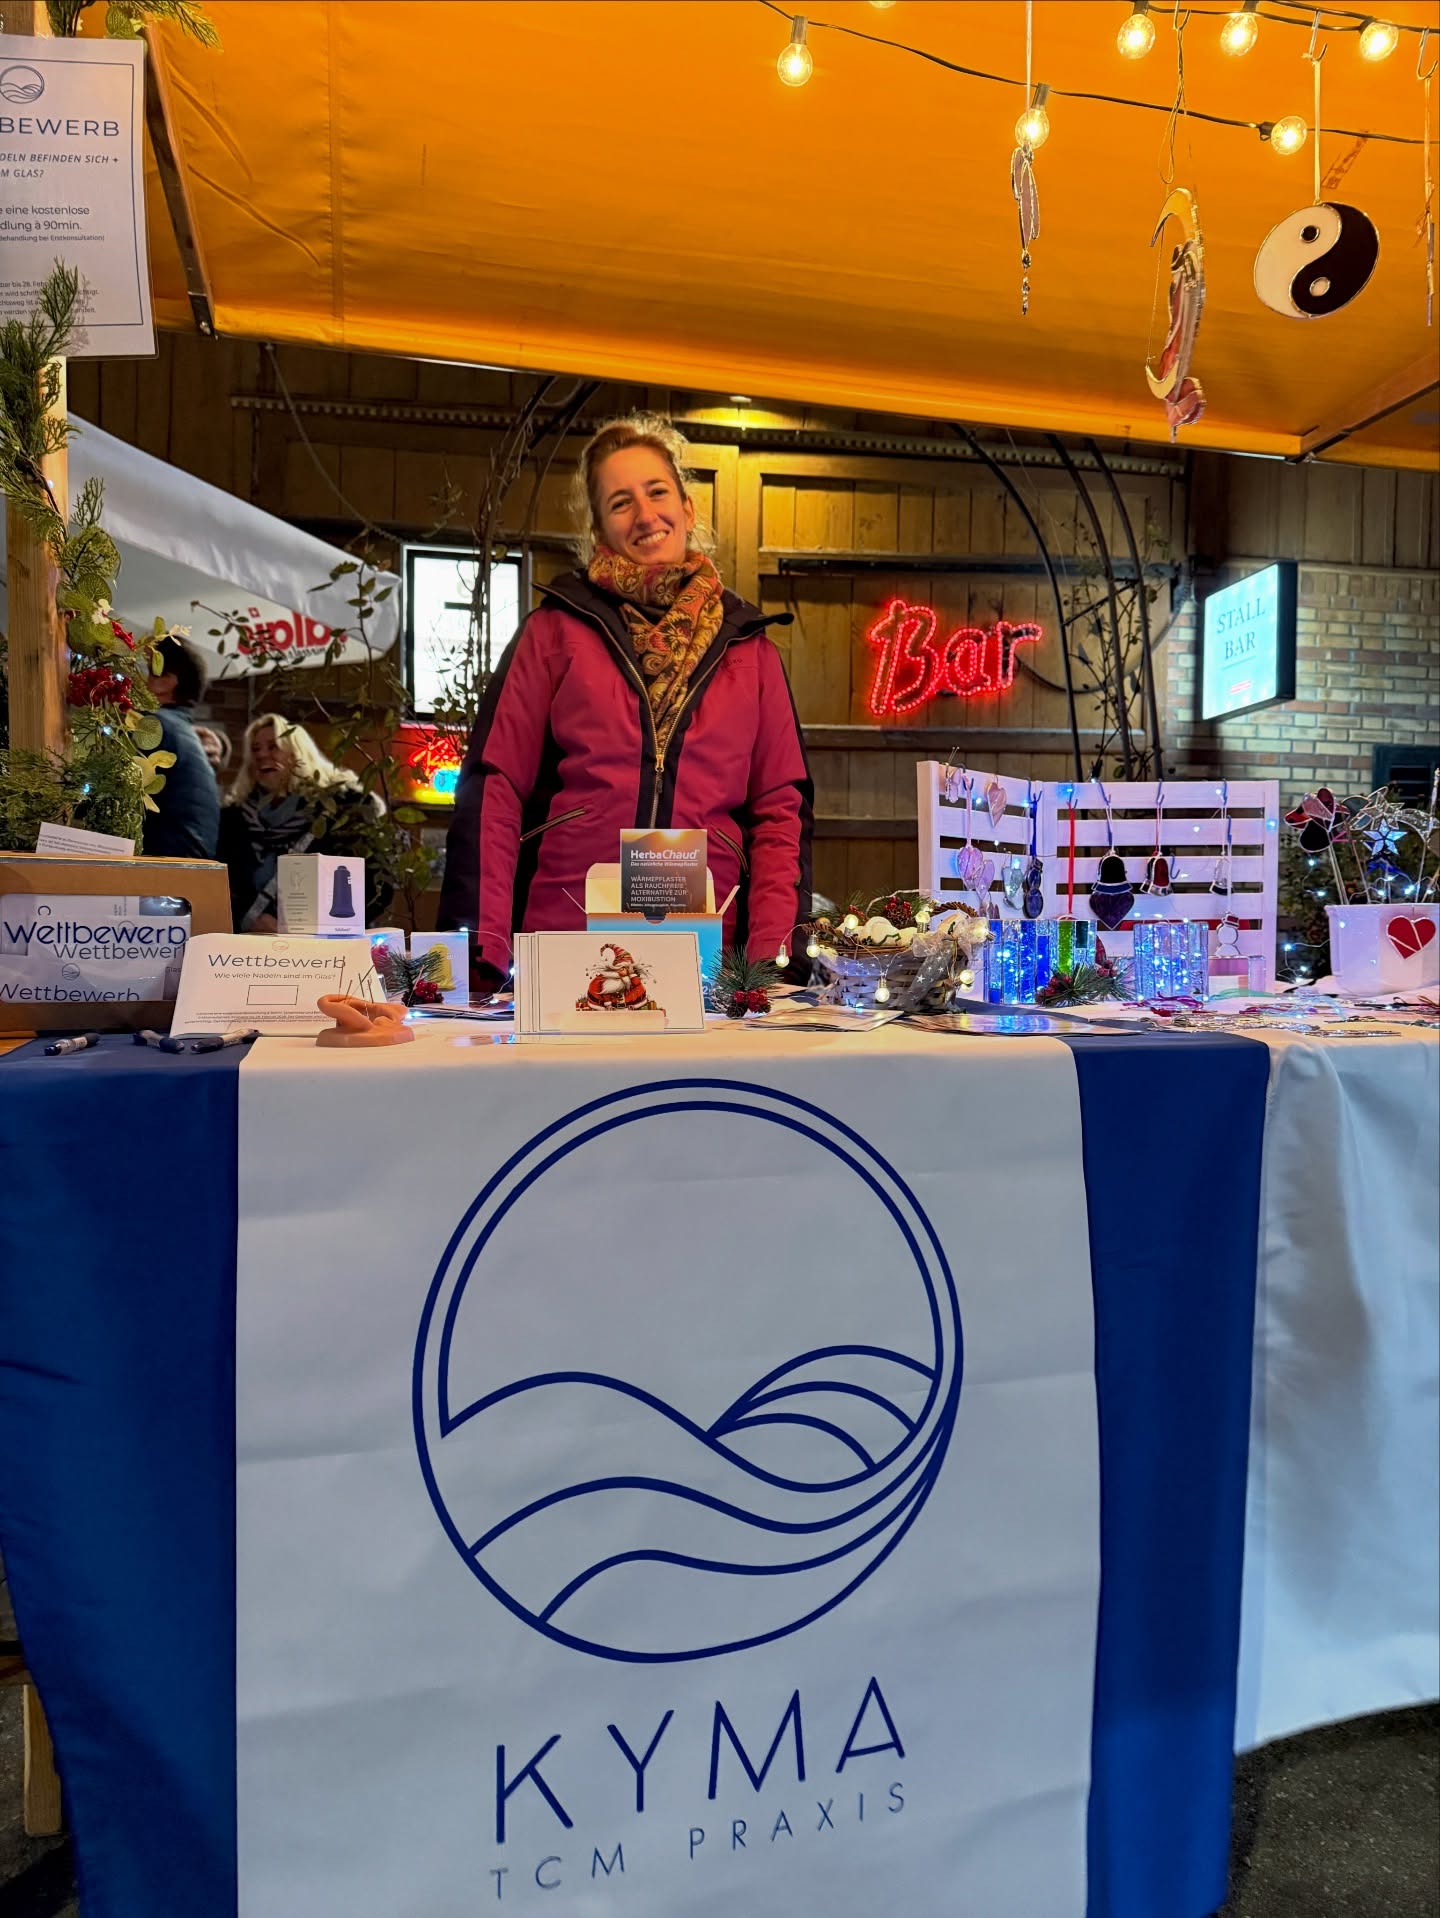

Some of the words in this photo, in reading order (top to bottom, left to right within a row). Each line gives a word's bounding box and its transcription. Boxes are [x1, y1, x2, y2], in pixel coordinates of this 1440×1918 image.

[0, 117, 119, 137] BEWERB
[30, 154, 81, 163] BEFINDEN
[85, 155, 109, 164] SICH
[13, 169, 44, 178] GLAS?
[5, 205, 29, 215] eine
[31, 205, 90, 215] kostenlose
[44, 220, 82, 230] 90min.
[1216, 598, 1265, 634] STALL
[1225, 631, 1256, 660] BAR
[869, 599, 1043, 715] Bar
[4, 921, 187, 945] Wettbewerb
[208, 954, 346, 969] Wettbewerb
[496, 1676, 905, 1844] KYMA
[490, 1843, 625, 1899] TCM
[689, 1782, 905, 1859] PRAXIS
